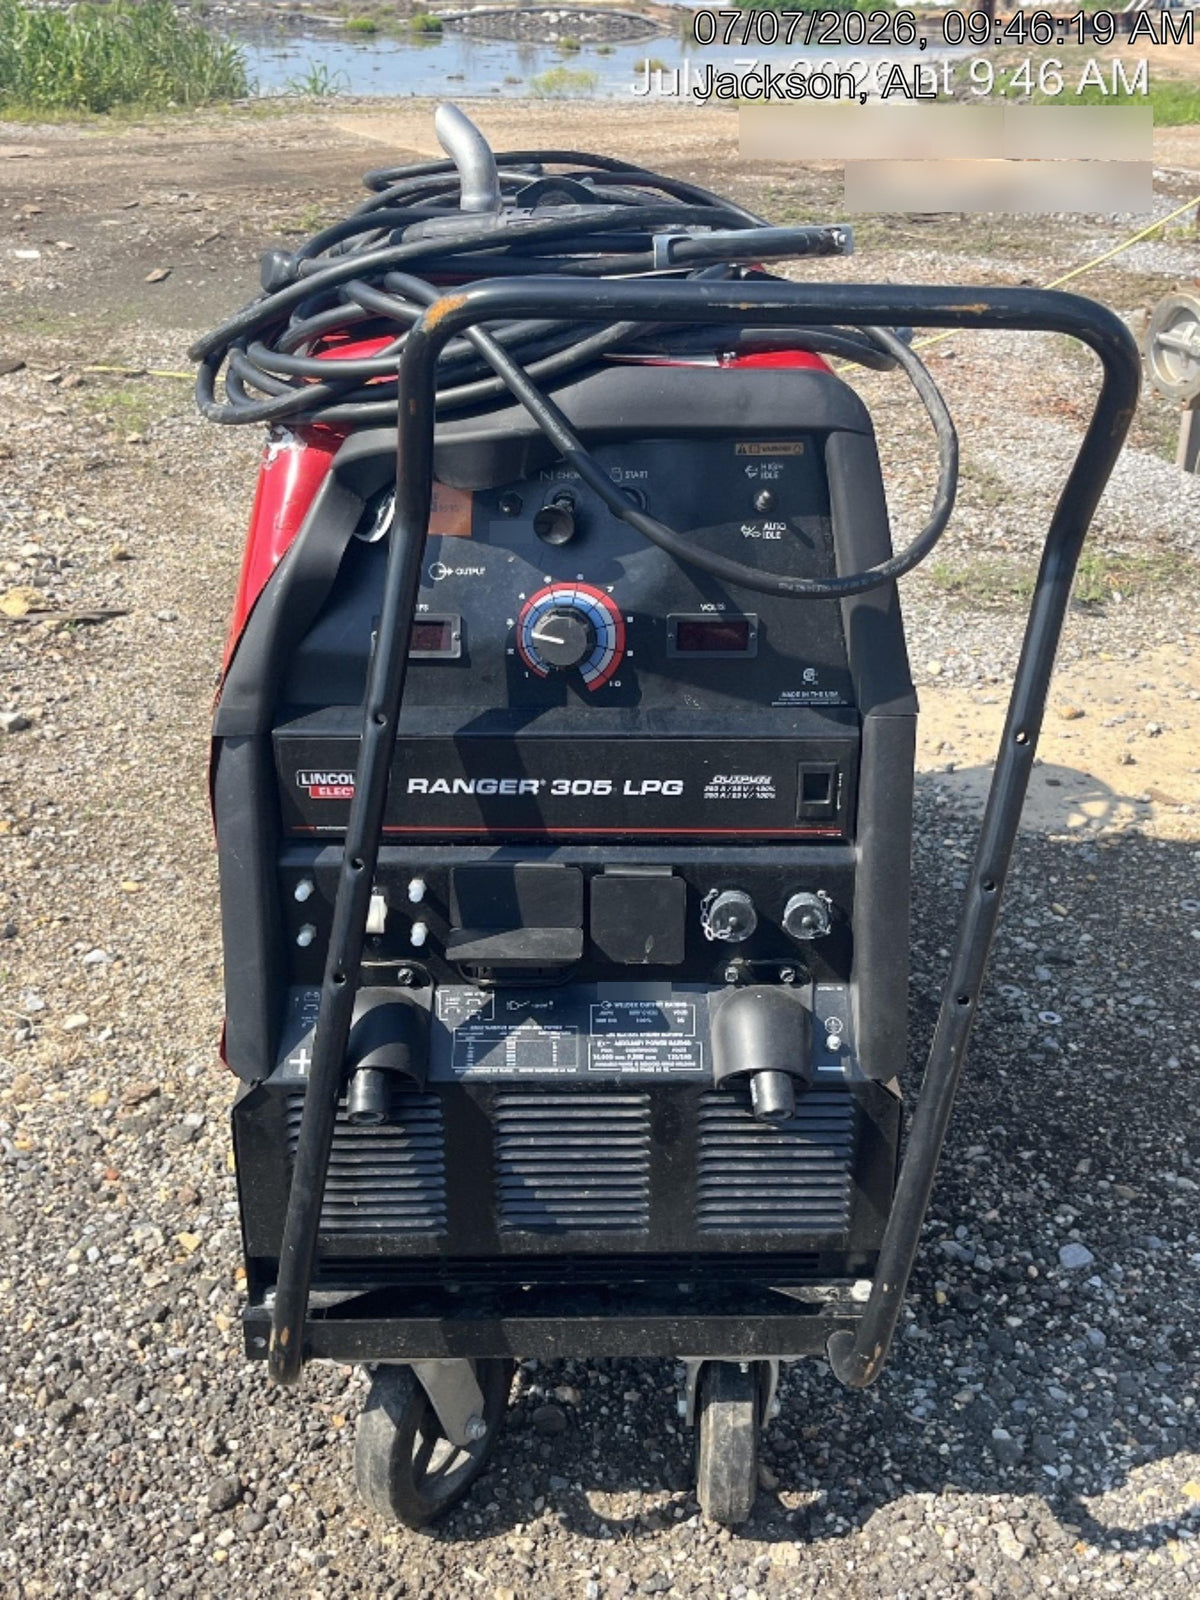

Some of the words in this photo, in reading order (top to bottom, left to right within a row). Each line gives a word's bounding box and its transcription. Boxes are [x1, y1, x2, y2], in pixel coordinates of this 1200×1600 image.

[625, 471, 648, 479] START
[761, 471, 780, 479] IDLE
[762, 522, 787, 531] AUTO
[762, 531, 782, 540] IDLE
[454, 567, 486, 575] OUTPUT
[700, 603, 726, 612] VOLTS
[609, 680, 622, 688] 10
[300, 773, 355, 785] LINCOL
[406, 778, 540, 795] RANGER
[550, 780, 613, 796] 305
[623, 780, 684, 796] LPG
